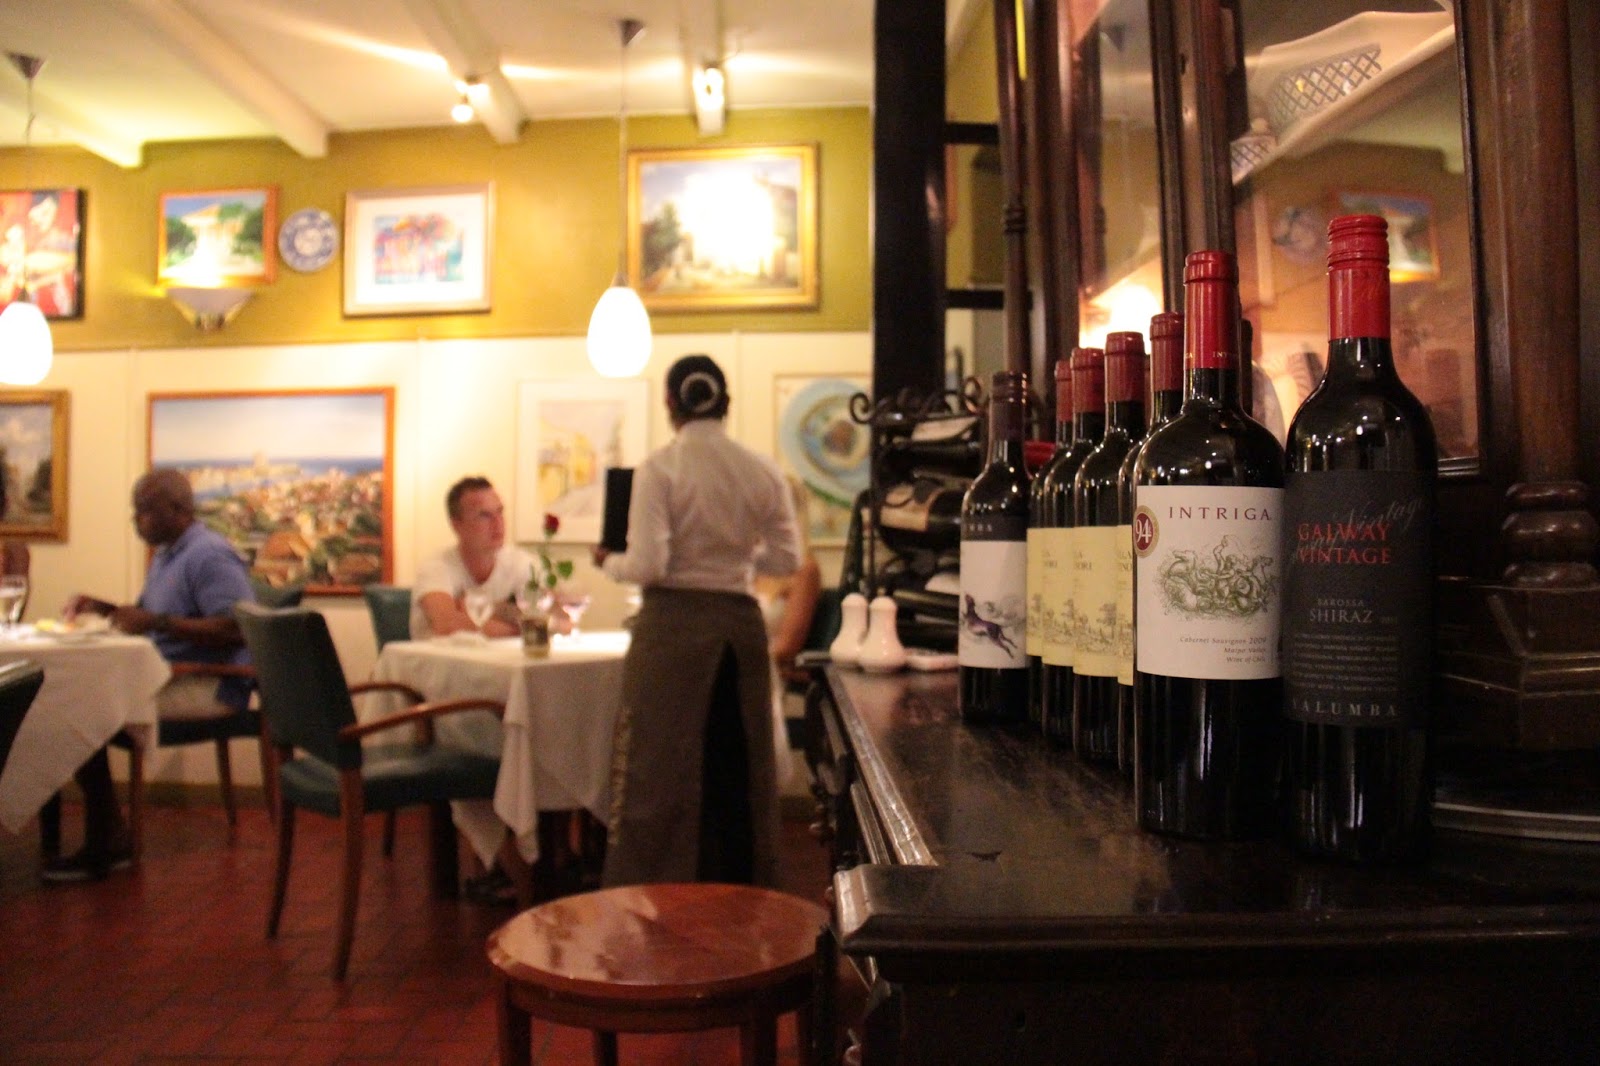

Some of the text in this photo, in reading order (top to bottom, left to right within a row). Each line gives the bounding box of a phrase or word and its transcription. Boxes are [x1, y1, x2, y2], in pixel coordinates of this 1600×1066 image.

[1169, 506, 1271, 521] INTRIGA
[1135, 518, 1152, 544] 94
[1298, 523, 1391, 541] GALWAY
[1297, 547, 1391, 565] VINTAGE
[1309, 608, 1373, 624] SHIRAZ
[1180, 635, 1210, 644] Cabernet
[1212, 637, 1247, 646] Sauvignon
